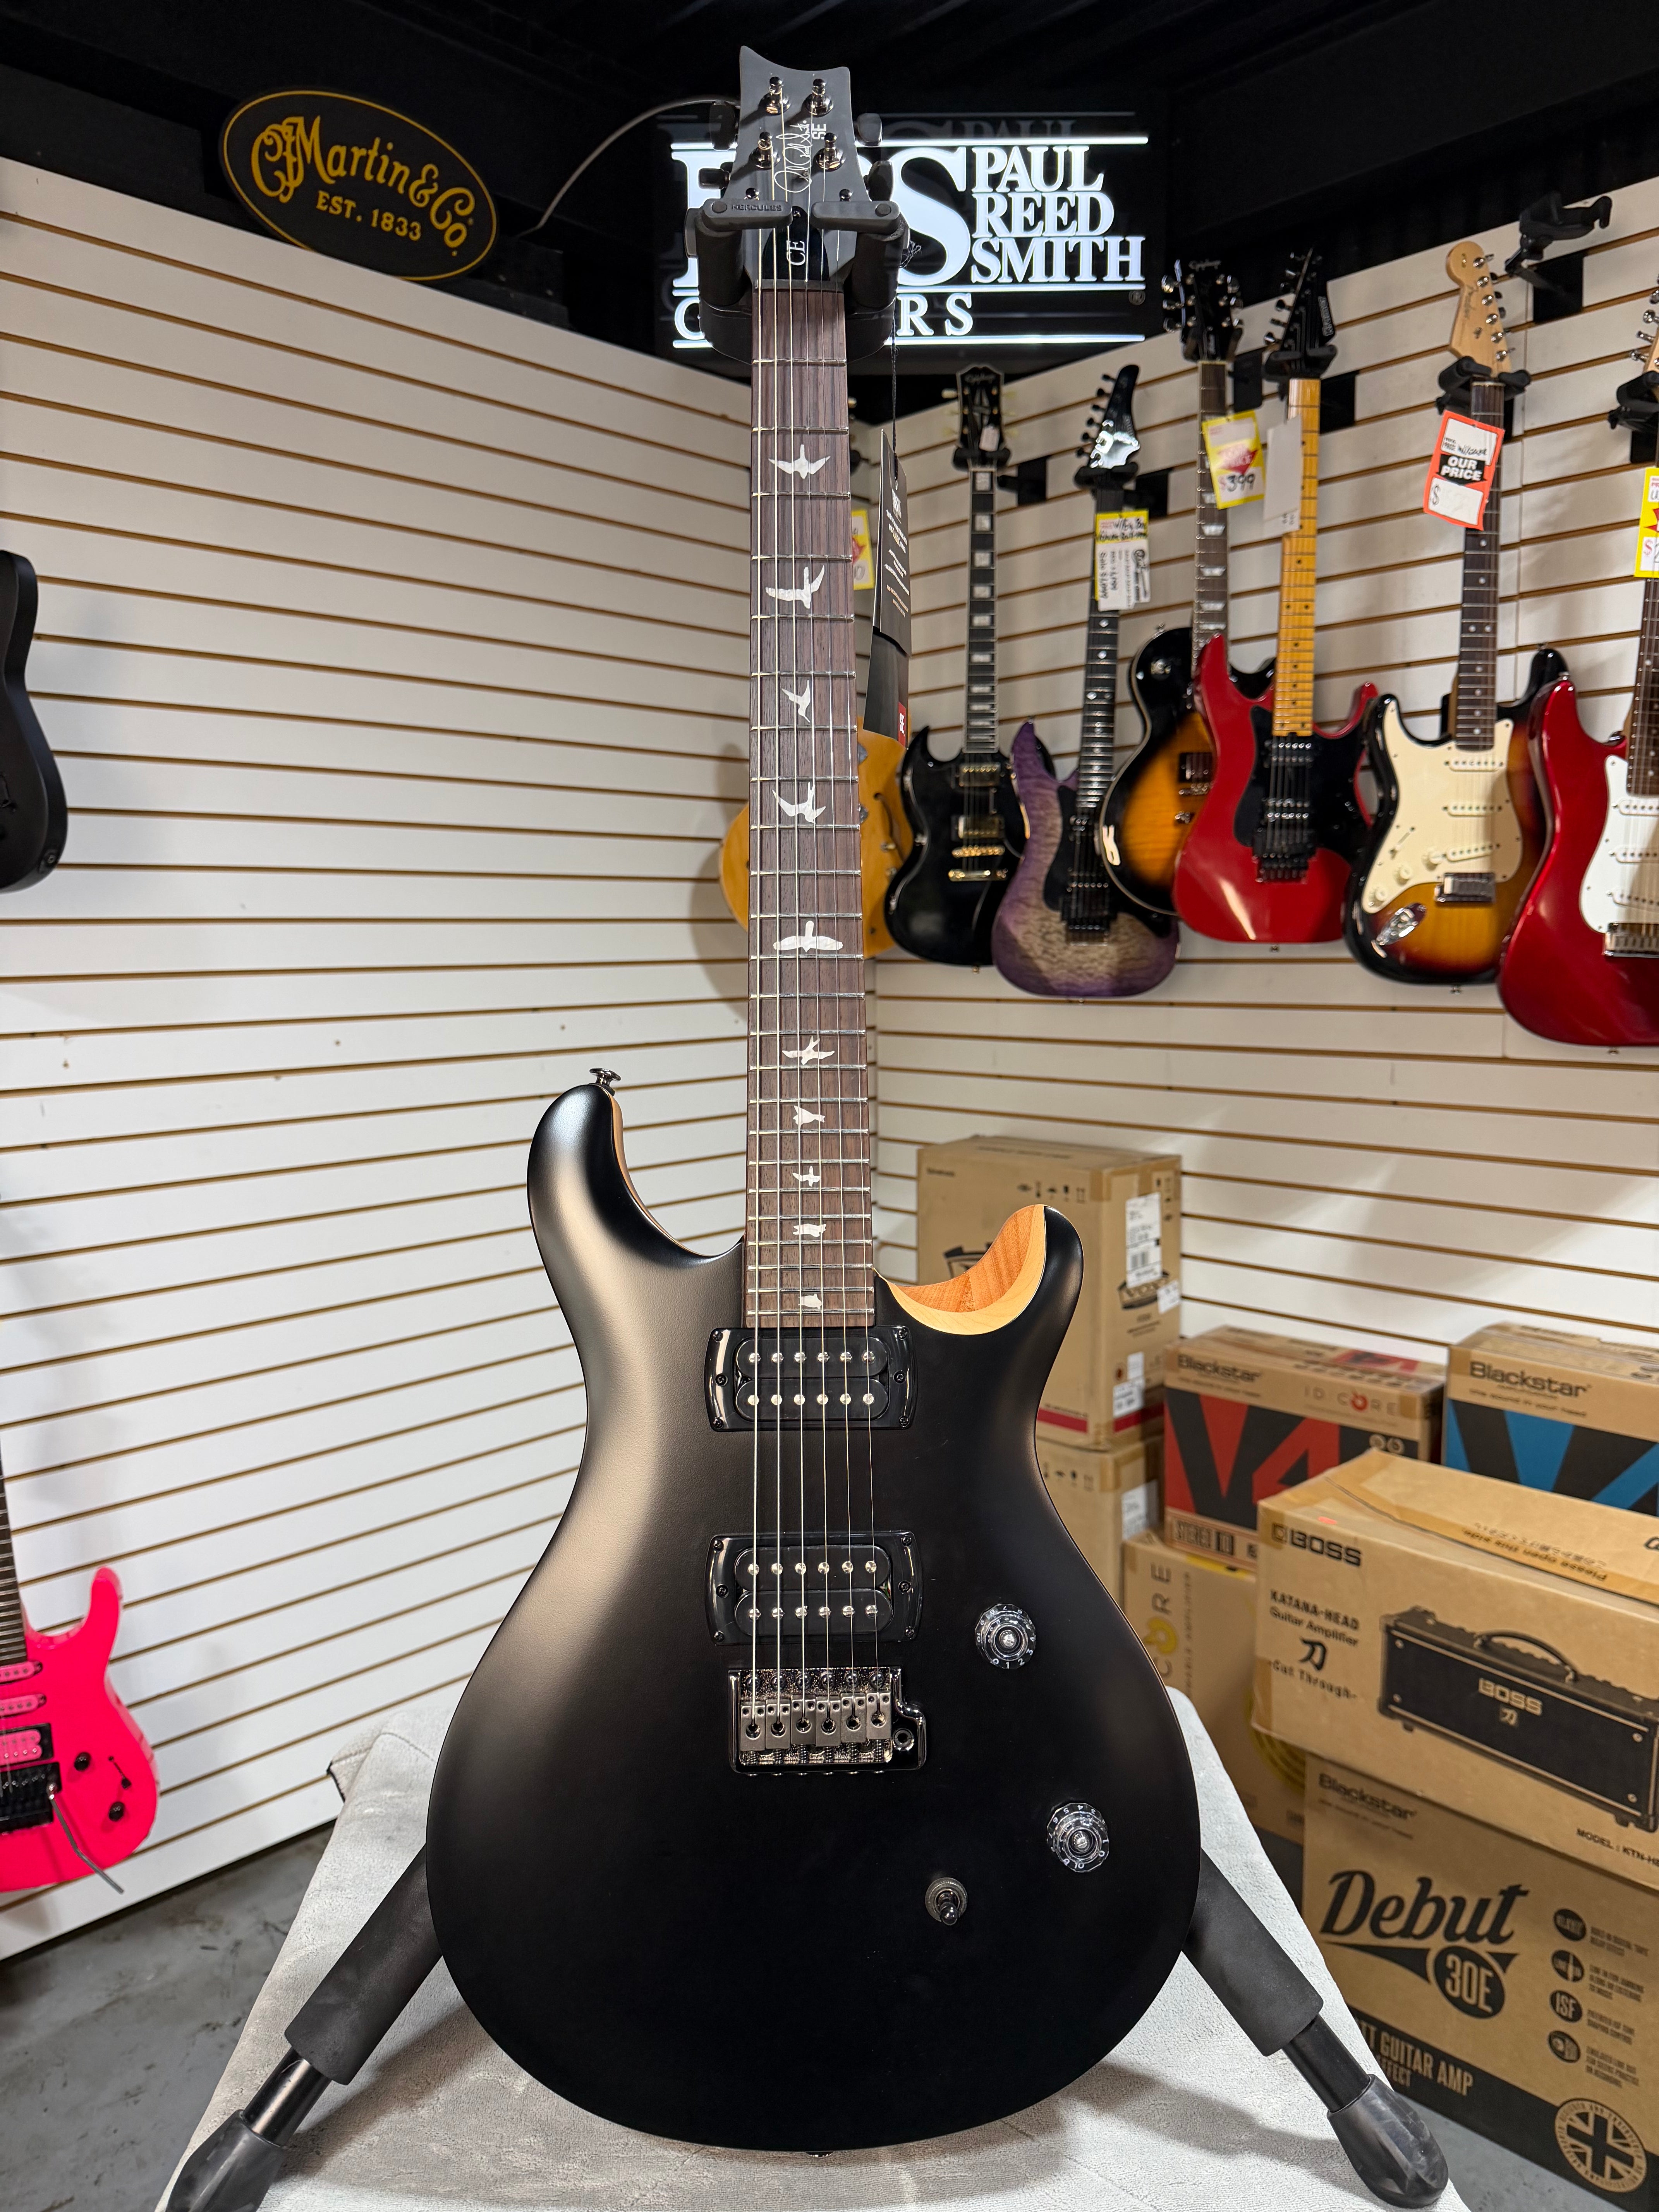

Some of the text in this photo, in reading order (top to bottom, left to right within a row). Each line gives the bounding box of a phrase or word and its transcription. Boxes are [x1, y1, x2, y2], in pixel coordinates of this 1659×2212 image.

[812, 123, 827, 140] SE
[971, 146, 1104, 192] PAUL
[316, 190, 422, 241] EST. 1833
[971, 192, 1114, 238] REED
[786, 240, 806, 266] CE
[971, 236, 1146, 283] SMITH
[1440, 465, 1482, 481] PRICE
[1448, 456, 1478, 470] OUR
[1470, 1361, 1588, 1397] Blackstar
[1290, 1529, 1362, 1566] BOSS
[1522, 1548, 1557, 1564] open
[1560, 1559, 1607, 1582] Please
[1270, 1606, 1359, 1646] Guitar Amplifier
[1271, 1589, 1360, 1630] KATANA-HEAD
[1478, 1677, 1543, 1717] BOSS
[1577, 1827, 1614, 1850] MODEL
[1320, 1870, 1529, 1944] Debut
[1445, 1953, 1494, 2014] 30E
[1556, 1992, 1577, 2019] ISF
[1380, 2031, 1434, 2079] GUITAR
[1437, 2060, 1474, 2096] AMP
